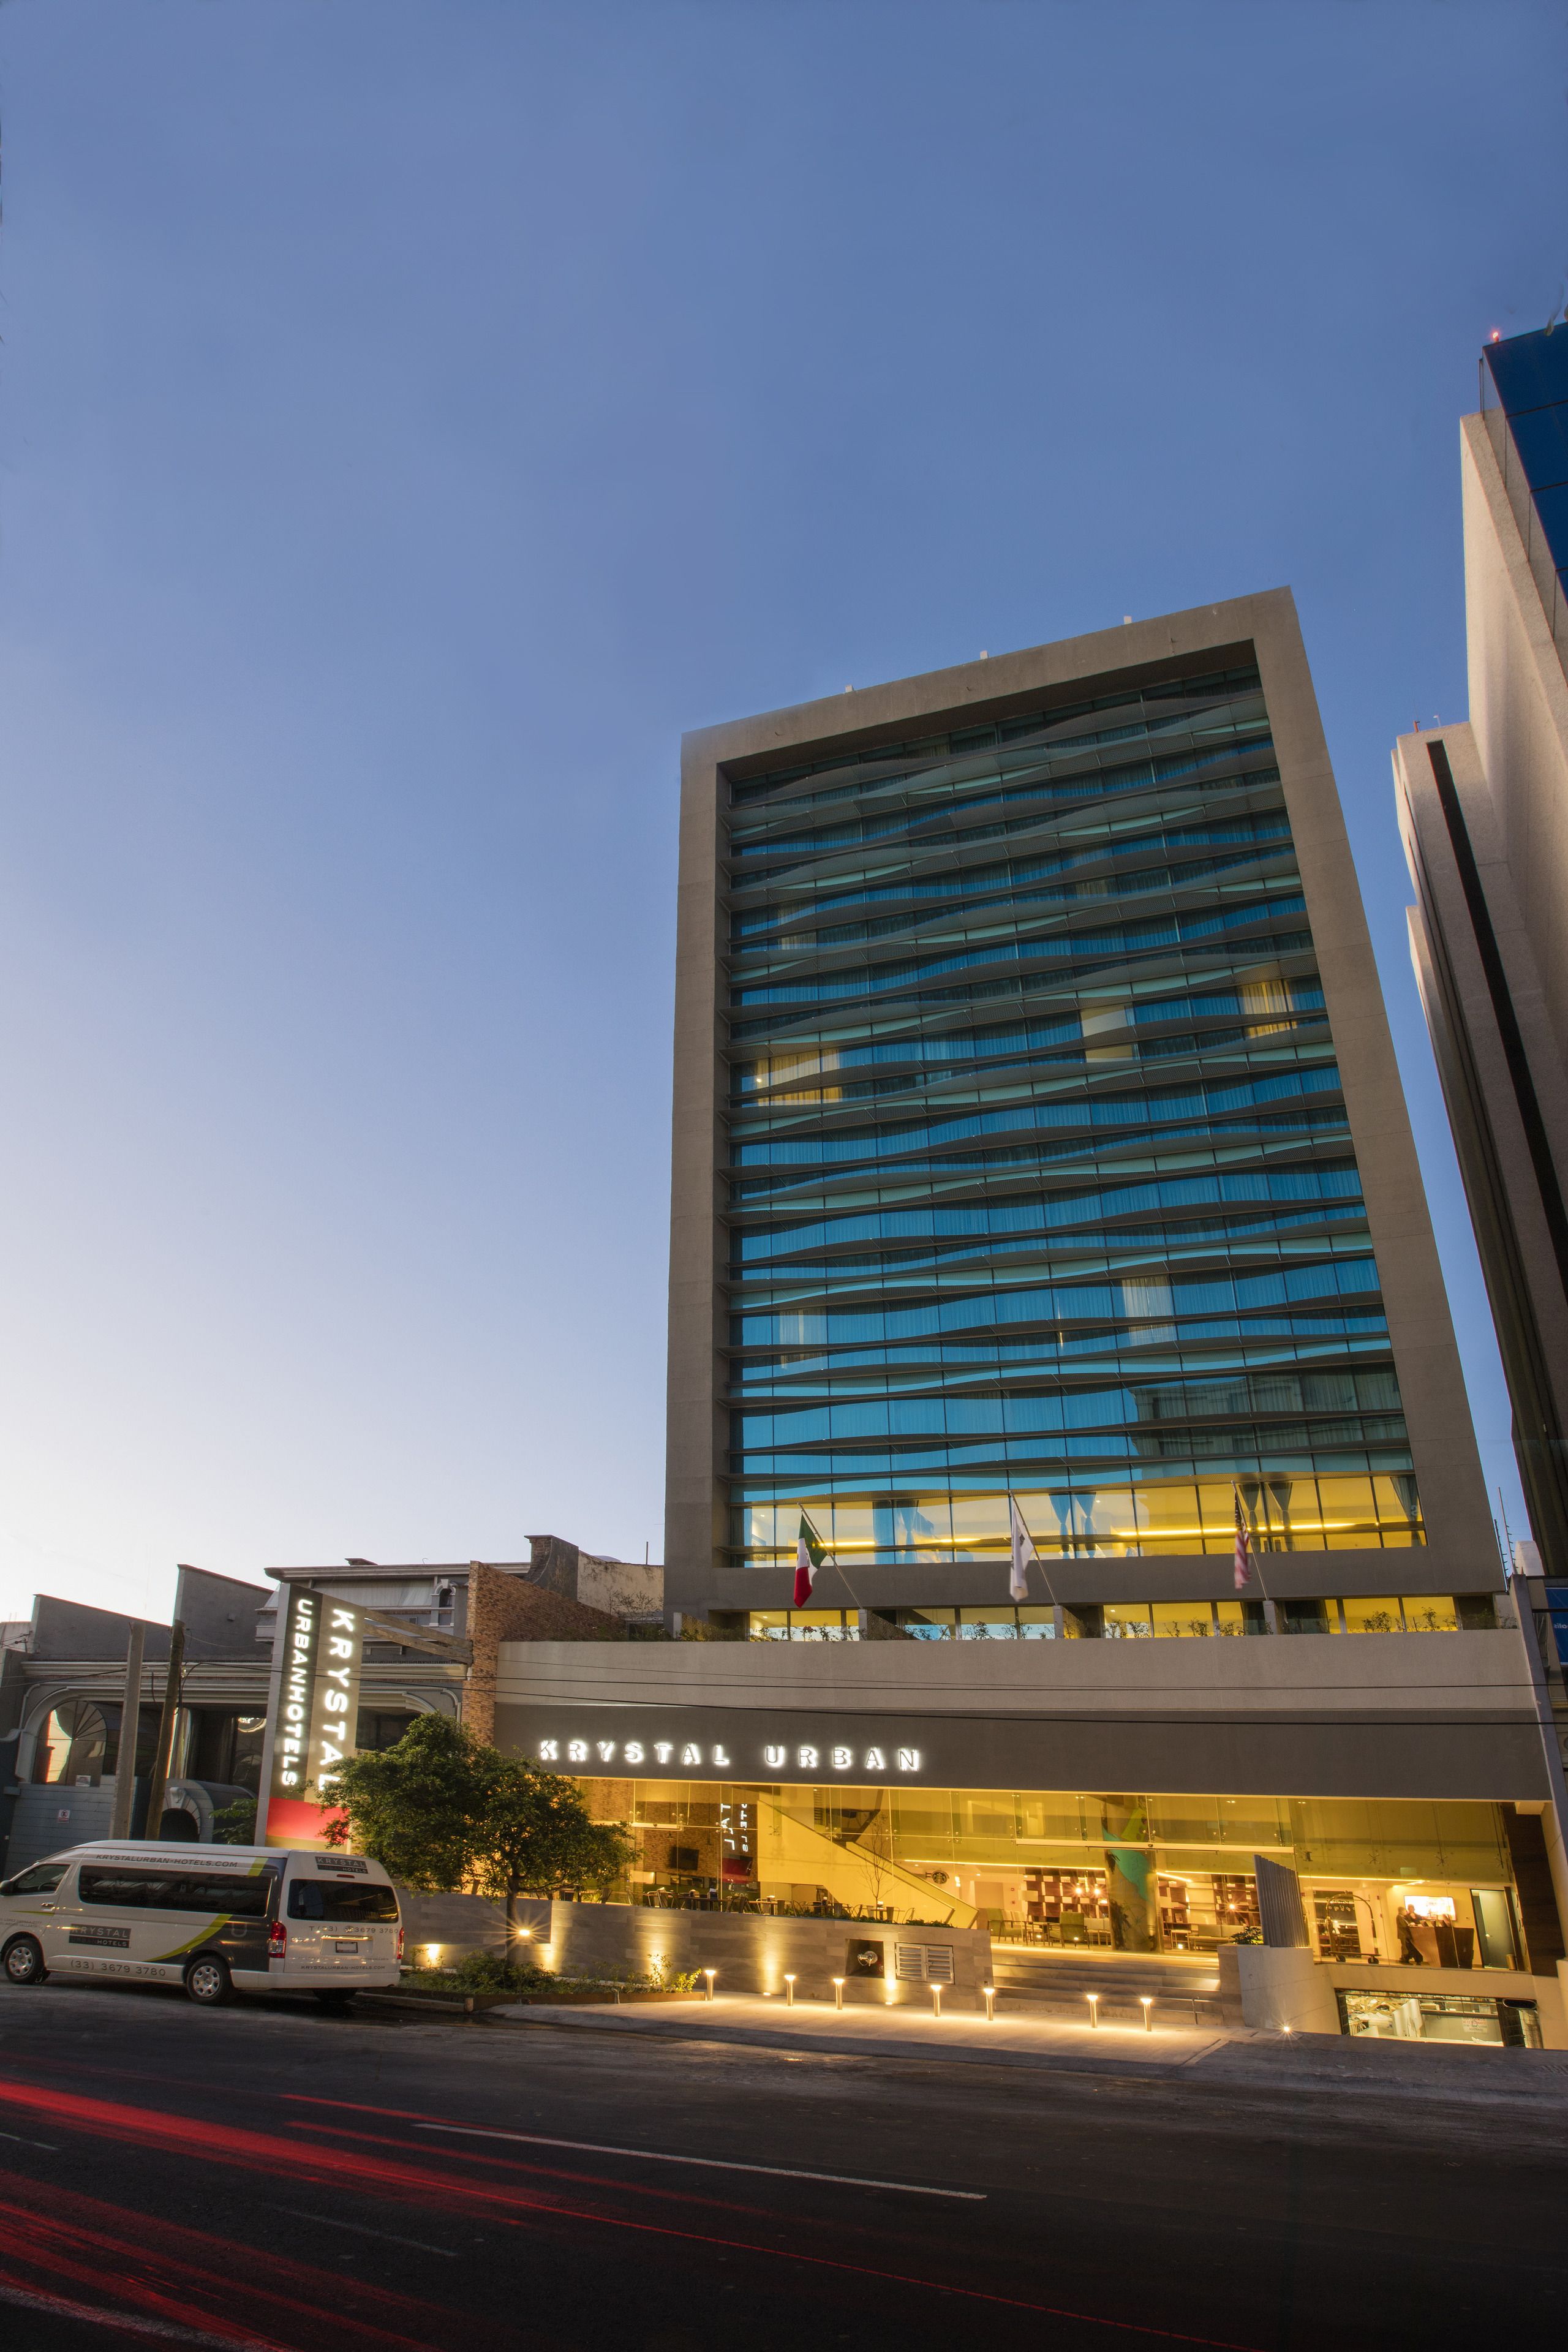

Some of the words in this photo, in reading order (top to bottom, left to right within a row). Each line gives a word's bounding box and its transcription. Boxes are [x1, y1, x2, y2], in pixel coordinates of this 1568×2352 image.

[282, 1599, 314, 1786] URBANHOTELS
[318, 1608, 355, 1792] KRYSTAL
[540, 1740, 730, 1766] KRYSTAL
[764, 1744, 920, 1771] URBAN
[96, 1854, 238, 1868] KRYSTALURBAN-HOTELS.COM
[317, 1858, 366, 1868] KRYSTAL
[70, 1925, 127, 1938] KRYSTAL
[70, 1959, 94, 1970] (33)
[102, 1963, 130, 1973] 3679
[135, 1967, 166, 1977] 3780
